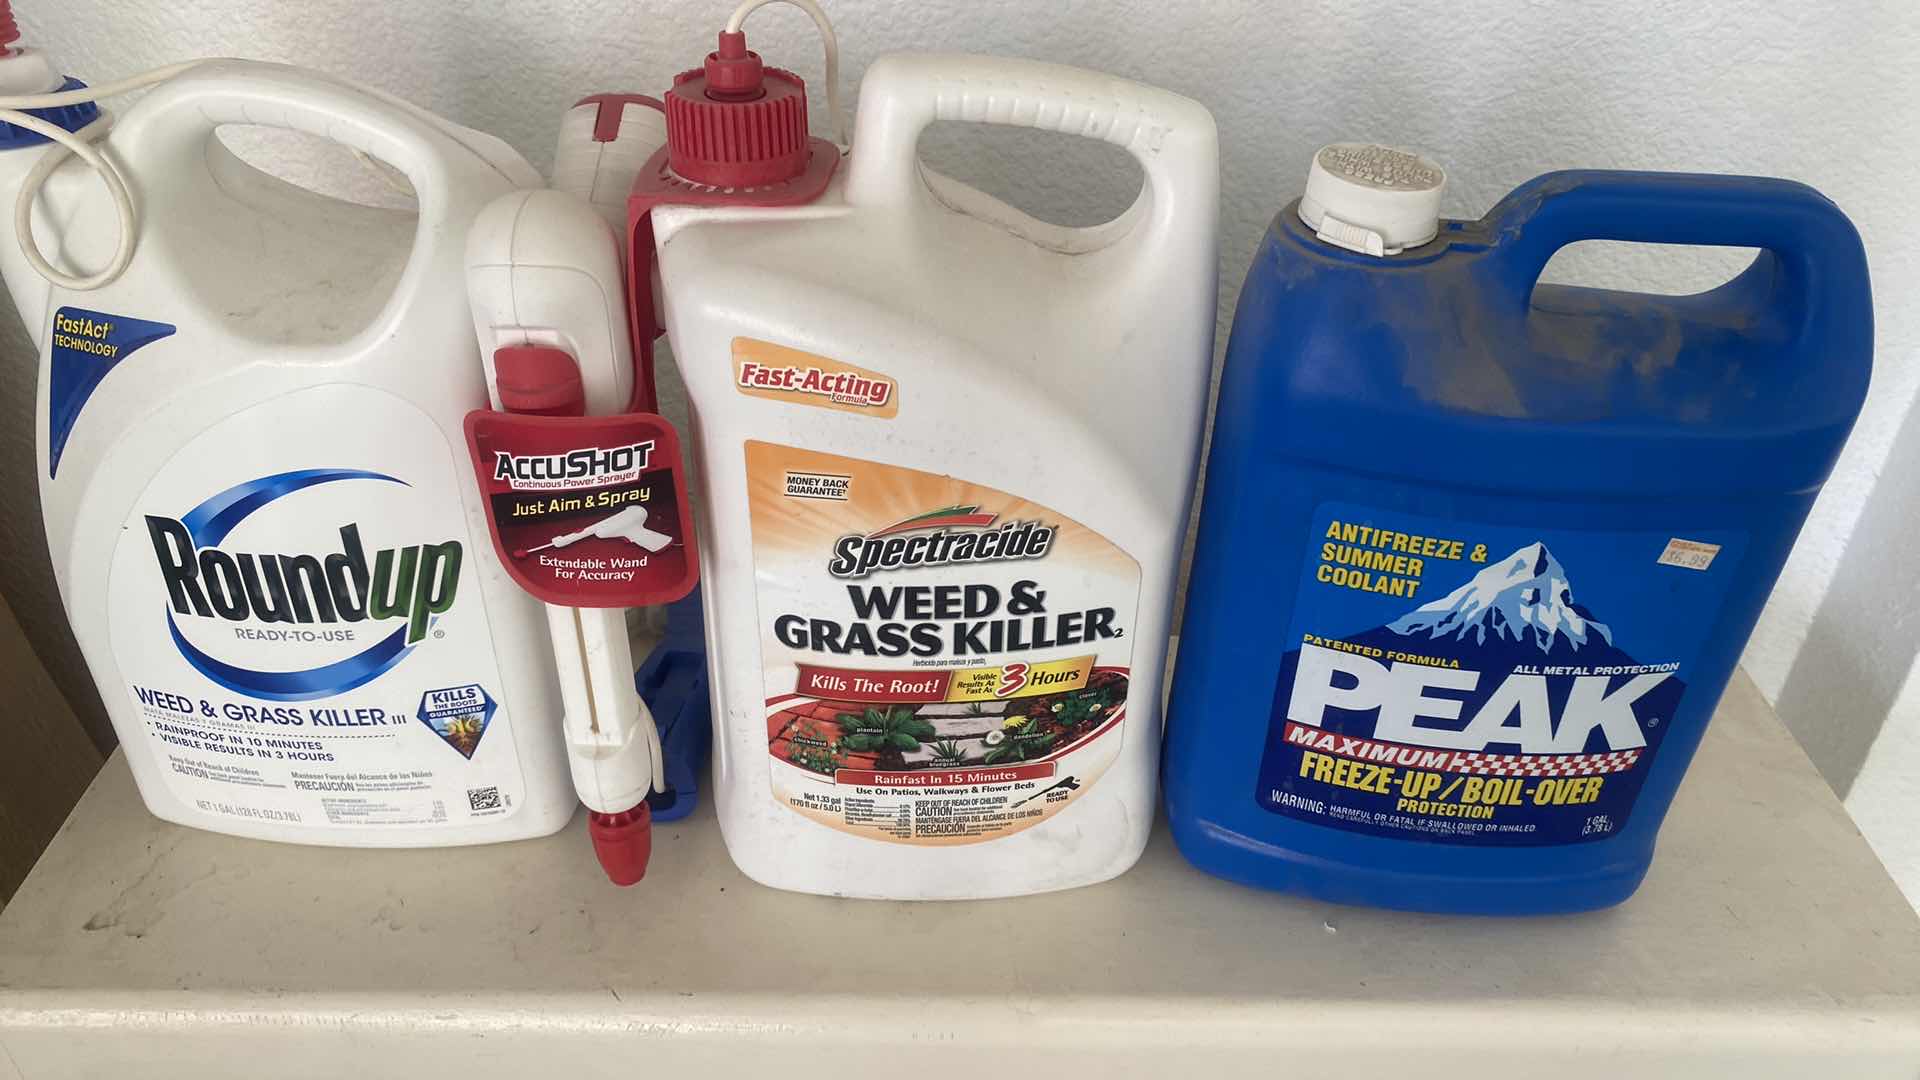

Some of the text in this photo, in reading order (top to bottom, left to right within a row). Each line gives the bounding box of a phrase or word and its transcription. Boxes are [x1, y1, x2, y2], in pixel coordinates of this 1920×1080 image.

[55, 334, 118, 358] TECHNOLOGY
[741, 363, 889, 402] Fast-Acting
[831, 393, 868, 405] Formula
[513, 471, 637, 489] Continuous Power Sprayer
[786, 476, 849, 489] MONEY BACK
[512, 487, 651, 517] Just Aim & Spray
[1325, 520, 1489, 563] ANTIFREEZE &
[831, 523, 1054, 578] Spectracide
[540, 555, 648, 570] Extendable Wand
[1321, 542, 1425, 578] SUMMER
[144, 515, 463, 644] Roundup
[555, 568, 634, 582] For Accuracy
[1316, 564, 1420, 599] COOLANT
[846, 579, 1047, 620] WEED &
[235, 628, 355, 642] READY-TO-USE
[773, 614, 943, 657] GRASS
[1302, 633, 1460, 669] PATENTED FORMULA
[972, 673, 997, 681] Visible
[1512, 662, 1681, 676] ALL METAL PROTECTION
[809, 675, 939, 695] Kills The Root!
[957, 680, 983, 688] Results
[995, 662, 1080, 697] 3 Hours
[432, 688, 476, 704] KILLS
[450, 698, 478, 708] ROOTS
[1286, 642, 1676, 753] PEAK
[133, 685, 407, 726] WEED & GRASS KILLER III
[429, 705, 482, 719] GUARANTEED
[155, 721, 323, 750] RAINPROOF IN 10 MINUTES
[856, 727, 883, 735] plantain
[160, 732, 335, 761] VISIBLE RESULTS IN 3 HOURS
[1288, 725, 1447, 770] MAXIMUM
[172, 762, 210, 780] CAUTION
[389, 772, 398, 780] de
[399, 771, 410, 779] los
[874, 770, 1017, 785] Rainfast In 15 Minutes
[856, 787, 873, 795] Use
[875, 788, 888, 796] On
[890, 787, 921, 797] Patios,
[924, 786, 969, 796] Walkways
[981, 785, 1012, 793] Flower
[1014, 782, 1035, 791] Beds
[1046, 790, 1069, 798] READY
[196, 800, 212, 811] NET
[790, 798, 804, 808] (170
[805, 800, 810, 808] fl
[823, 802, 834, 811] 5.0
[804, 792, 815, 801] Net
[816, 795, 830, 804] 1.33
[831, 796, 841, 804] gal
[915, 799, 930, 807] KEEP
[952, 798, 971, 806] REACH
[981, 796, 1008, 804] CHILDREN
[915, 807, 953, 817] CAUTION
[953, 815, 970, 823] FUERA
[982, 813, 1007, 822] ALCANCE
[1007, 811, 1015, 819] DE
[1271, 789, 1326, 815] WARNING:
[1329, 804, 1371, 819] HARMFUL
[1374, 812, 1387, 821] OR
[1389, 815, 1414, 826] FATAL
[1417, 818, 1426, 826] IF
[1428, 820, 1483, 832] SWALLOWED
[1485, 823, 1498, 832] OR
[1397, 798, 1495, 820] PROTECTION
[1586, 817, 1591, 826] 1
